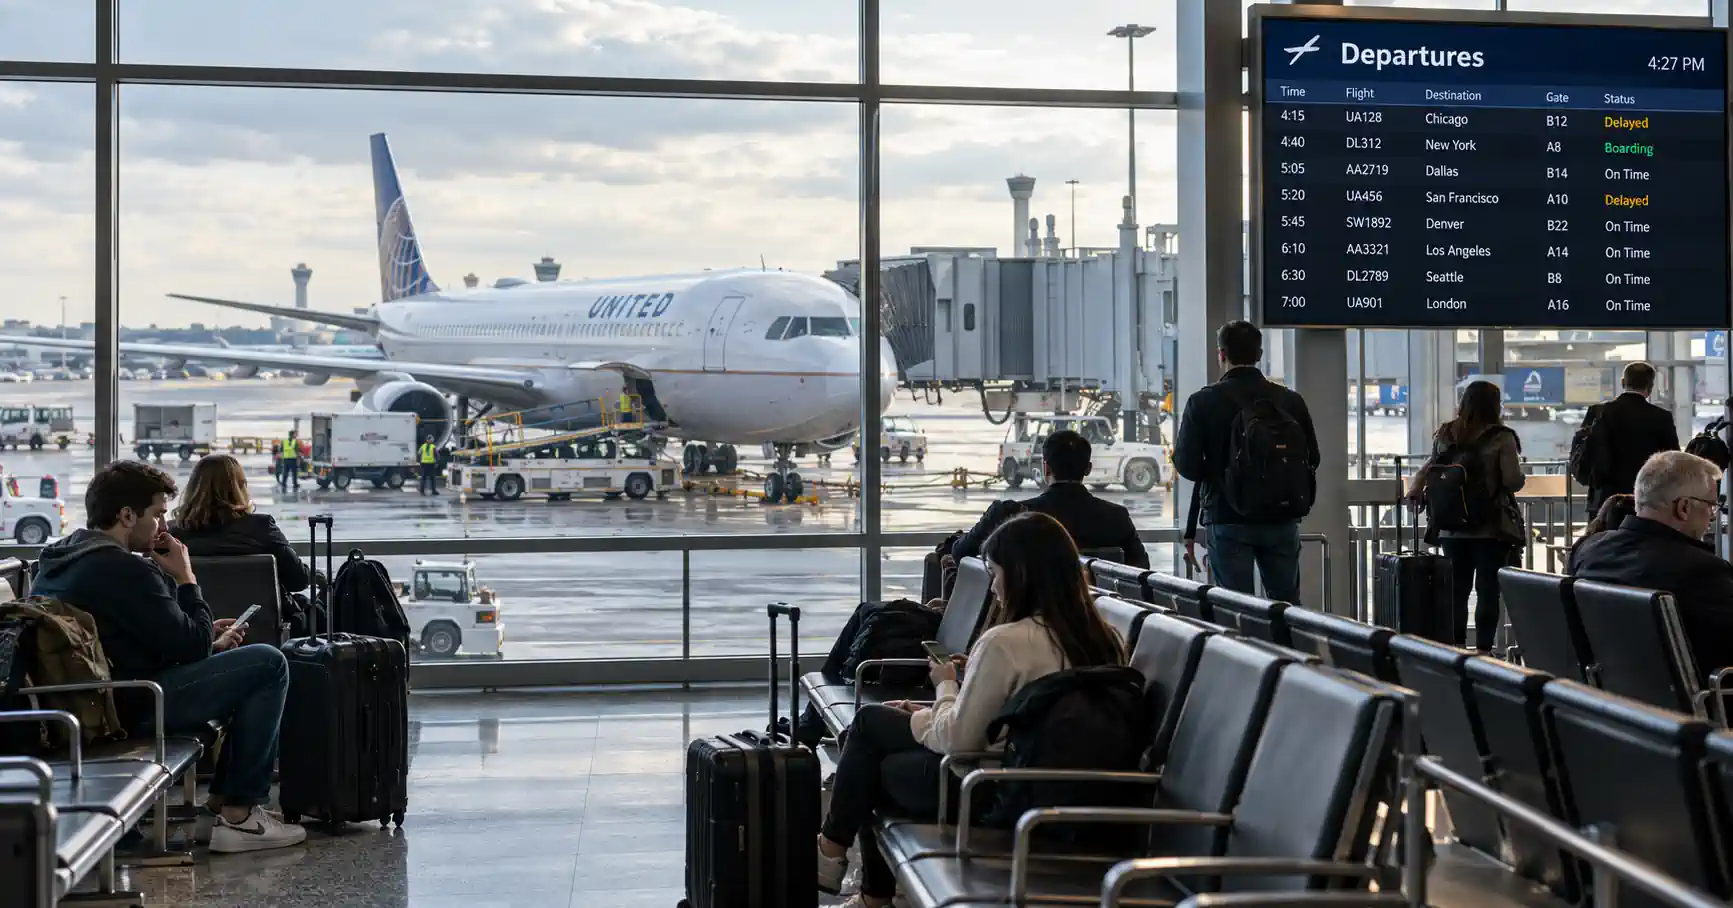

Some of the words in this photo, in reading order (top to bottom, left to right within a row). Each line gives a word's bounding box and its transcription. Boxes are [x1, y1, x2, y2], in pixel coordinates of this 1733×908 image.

[1341, 41, 1485, 71] Departures
[1647, 55, 1679, 71] 4:27
[1682, 56, 1705, 72] PM
[1280, 85, 1306, 97] Time
[1346, 87, 1375, 101] Flight
[1425, 89, 1482, 101] Destination
[1545, 91, 1570, 104] Gate
[1603, 93, 1636, 105] Status
[1280, 109, 1305, 122] 4:15
[1345, 110, 1383, 123] UA128
[1425, 112, 1469, 127] Chicago
[1546, 115, 1568, 127] B12
[1604, 116, 1649, 130] Delayed
[1280, 135, 1305, 148] 4:40
[1346, 136, 1382, 149] DL312
[1425, 138, 1449, 150] New
[1452, 138, 1477, 151] York
[1546, 141, 1562, 153] A8
[1604, 142, 1654, 157] Boarding
[1280, 162, 1305, 175] 5:05
[1345, 163, 1389, 176] AA2719
[1425, 164, 1459, 177] Dallas
[1546, 167, 1569, 179] B14
[1604, 168, 1621, 180] On
[1623, 168, 1650, 180] Time
[1280, 188, 1306, 201] 5:20
[1346, 189, 1383, 202] UA456
[1425, 191, 1445, 204] San
[1447, 191, 1500, 204] Francisco
[1546, 193, 1569, 205] A10
[1605, 194, 1649, 208] Delayed
[1281, 215, 1306, 228] 5:45
[1346, 216, 1392, 229] SW1892
[1425, 217, 1465, 230] Denver
[1547, 219, 1569, 232] B22
[1605, 220, 1621, 233] On
[1623, 220, 1651, 233] Time
[1281, 242, 1306, 255] 6:10
[1346, 243, 1389, 256] AA3321
[1426, 244, 1444, 257] Los
[1447, 244, 1492, 260] Angeles
[1547, 245, 1569, 258] A14
[1605, 246, 1621, 259] On
[1623, 246, 1651, 259] Time
[1281, 268, 1306, 281] 6:30
[1346, 269, 1389, 282] DL2789
[1425, 270, 1464, 283] Seattle
[1547, 272, 1563, 284] B8
[1605, 272, 1622, 285] On
[1623, 273, 1651, 285] Time
[588, 292, 675, 319] UNITED
[1281, 295, 1306, 308] 7:00
[1346, 296, 1383, 309] UA901
[1426, 297, 1467, 310] London
[1547, 298, 1570, 311] A16
[1605, 299, 1622, 312] On
[1623, 299, 1651, 312] Time
